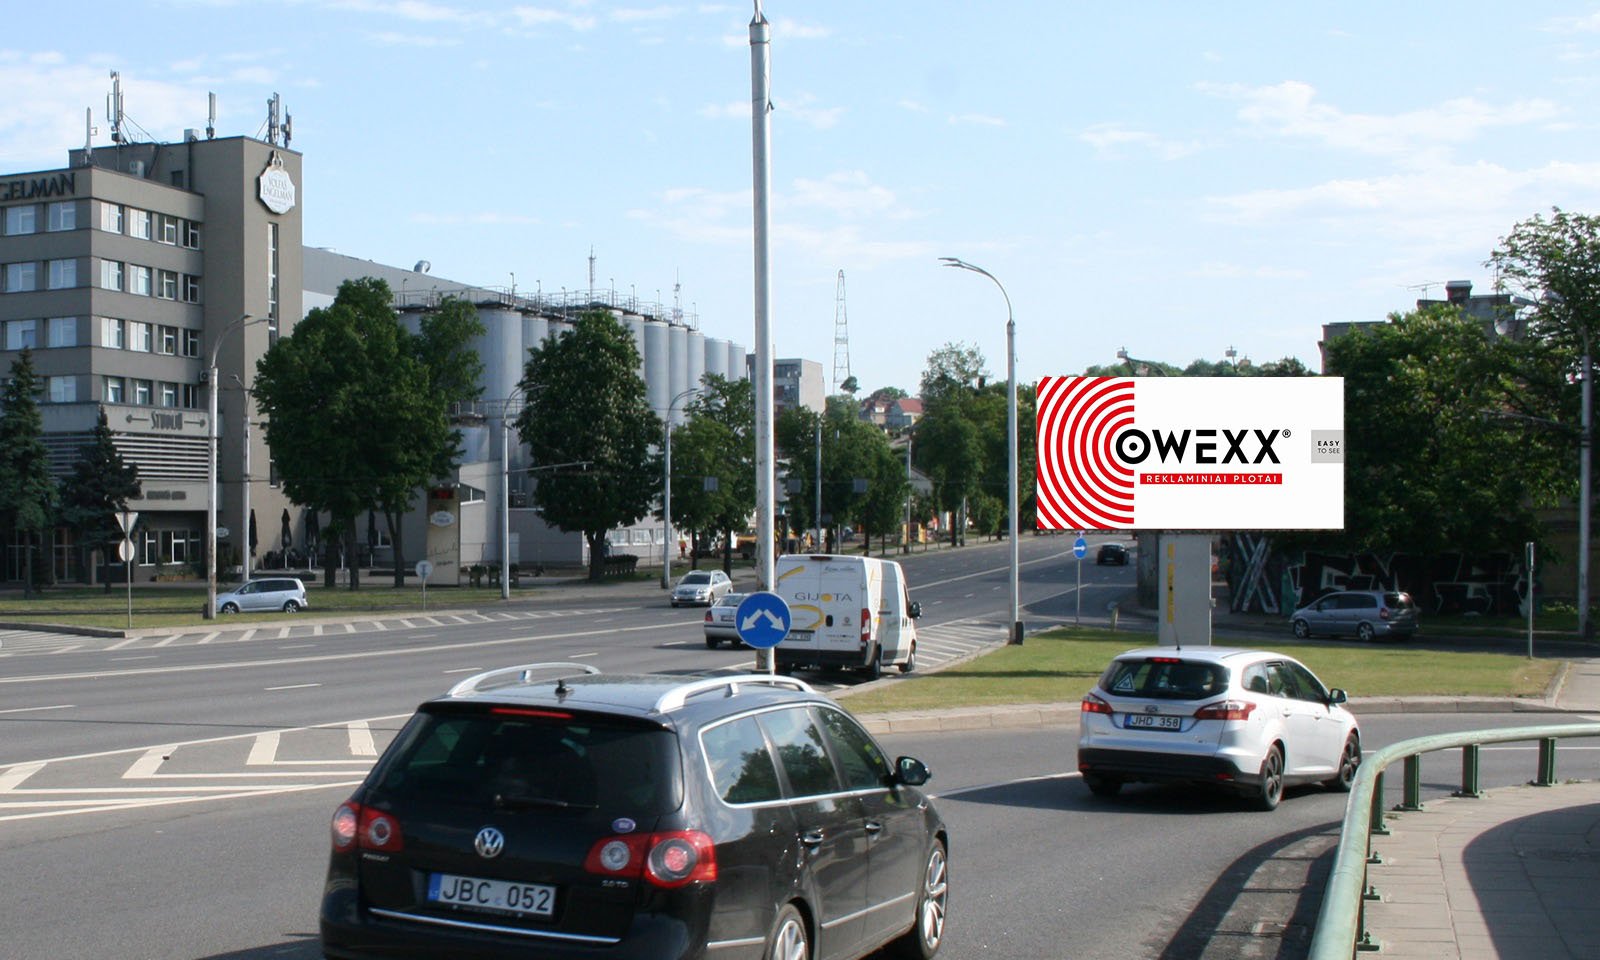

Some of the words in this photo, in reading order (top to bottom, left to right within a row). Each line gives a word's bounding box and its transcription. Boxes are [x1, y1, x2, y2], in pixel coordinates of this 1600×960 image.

[1146, 475, 1227, 483] REKLAMINIAI
[1233, 475, 1278, 483] PLOTAI
[1132, 716, 1153, 726] JHD
[1159, 717, 1179, 728] 358
[442, 879, 491, 904] JBC
[507, 885, 550, 911] 052
